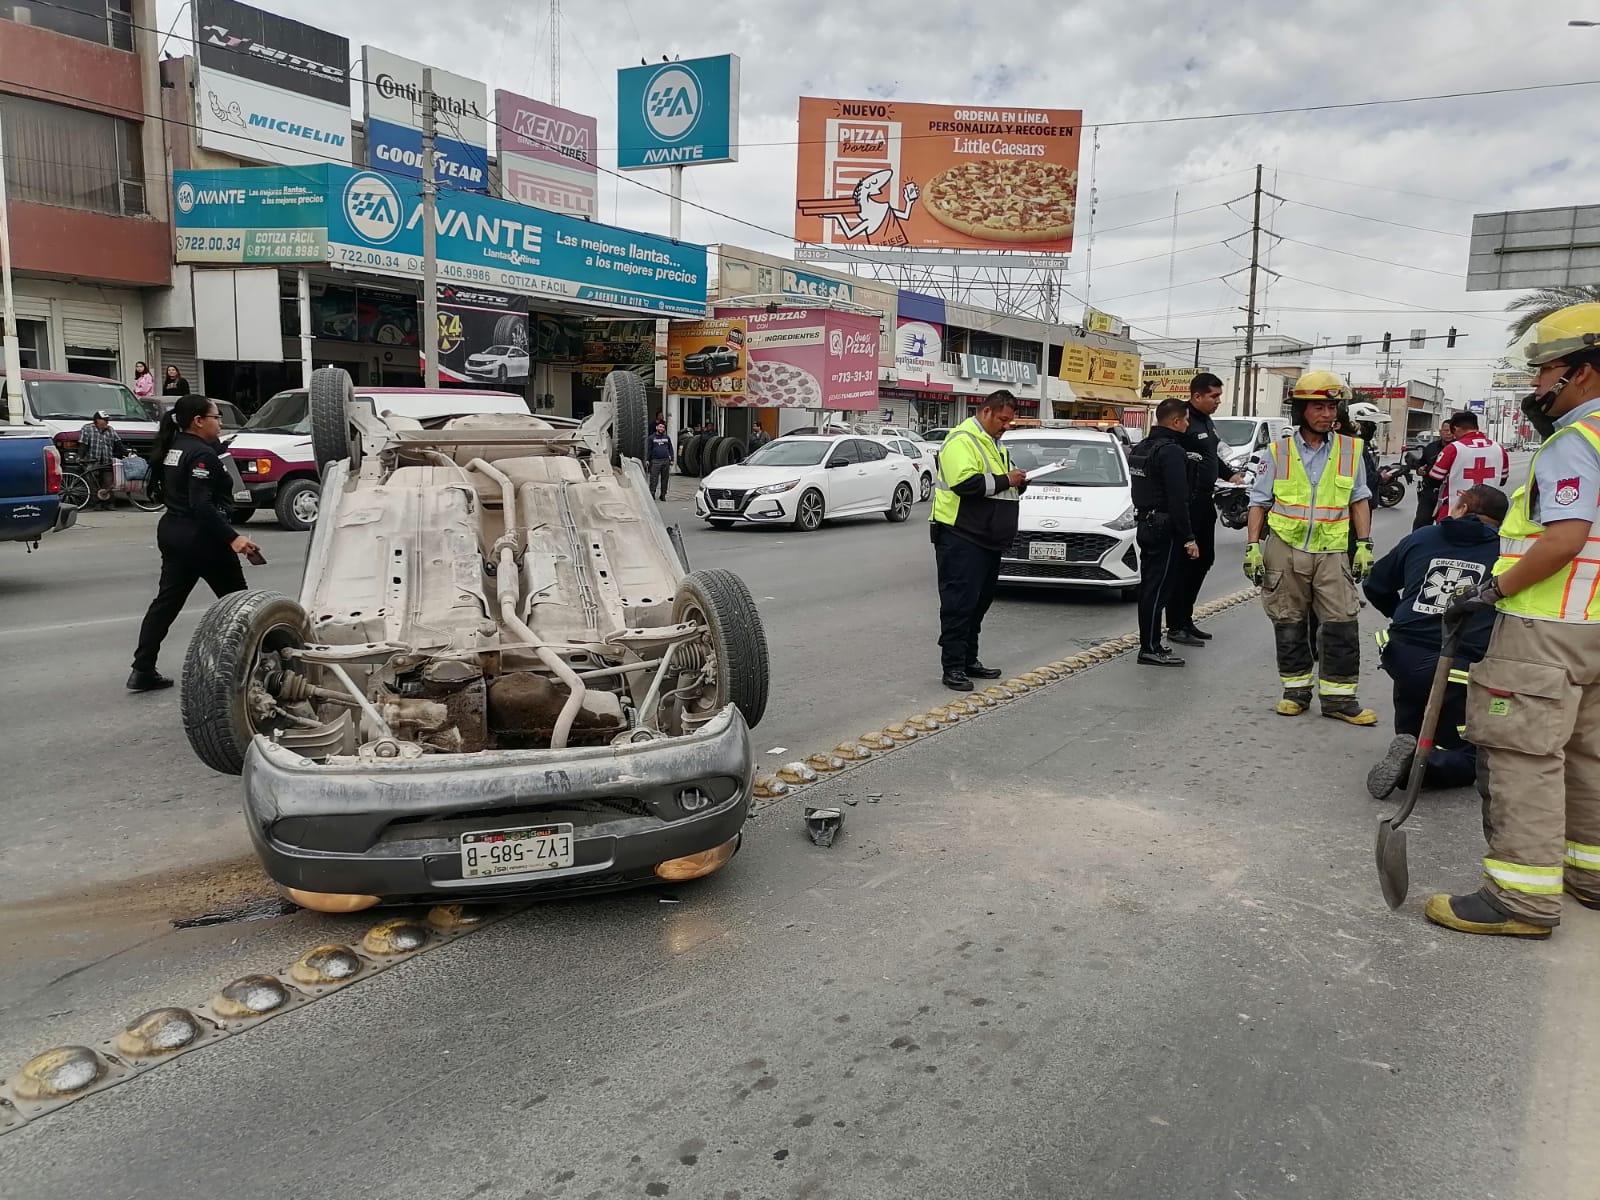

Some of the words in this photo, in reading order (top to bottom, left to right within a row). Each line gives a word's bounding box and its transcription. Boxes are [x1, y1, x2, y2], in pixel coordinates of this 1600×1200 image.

[249, 43, 344, 77] NITTO
[842, 104, 887, 118] NUEVO
[954, 109, 999, 122] ORDENA
[1002, 112, 1016, 123] EN
[1018, 111, 1049, 124] LÍNEA
[248, 112, 345, 147] MICHELIN
[512, 108, 589, 154] KENDA
[840, 128, 886, 145] PIZZA
[929, 121, 1003, 134] PERSONALIZA
[1005, 125, 1014, 134] Y
[1015, 125, 1057, 136] RECOGE
[1059, 127, 1073, 137] EN
[560, 148, 588, 162] TIRES
[643, 145, 704, 163] AVANTE
[842, 142, 884, 153] Portal
[953, 137, 990, 154] Little
[991, 138, 1046, 156] Caesars
[195, 188, 246, 205] AVANTE
[508, 168, 594, 214] PIRELLI
[298, 195, 324, 206] precios
[185, 235, 240, 250] 722.00.34
[255, 231, 287, 244] COTIZA
[557, 230, 579, 247] Las
[581, 238, 627, 257] mejores
[629, 243, 682, 268] llantas...
[340, 250, 400, 270] 722.00.34
[585, 257, 593, 265] a
[596, 256, 612, 269] los
[614, 262, 654, 279] mejores
[655, 267, 698, 286] precios
[501, 273, 538, 290] COTIZA
[540, 278, 568, 294] FÁCIL
[749, 314, 769, 323] TUS
[769, 310, 808, 322] PIZZAS
[765, 331, 820, 343] INGREDIENTES
[845, 334, 877, 358] Pizzas
[974, 355, 988, 375] La
[1142, 369, 1170, 377] FARMACIA
[1456, 562, 1480, 571] VERDE
[467, 837, 569, 867] EYZ-585-B
